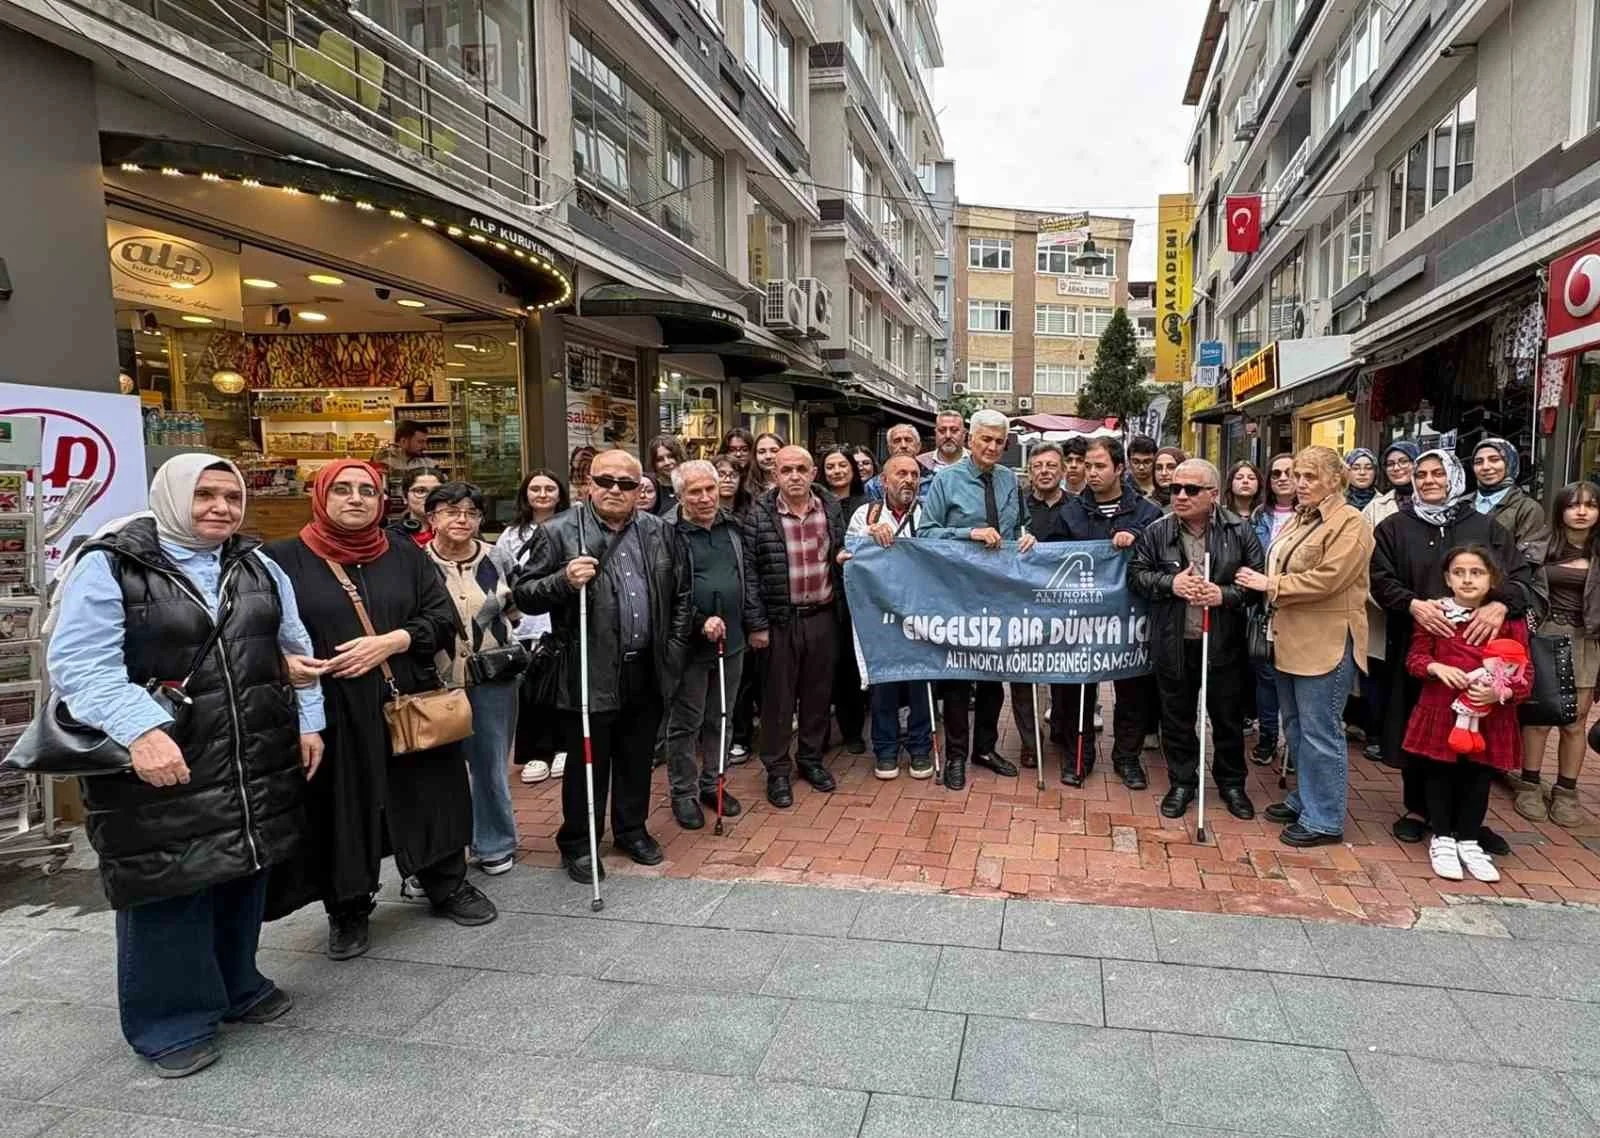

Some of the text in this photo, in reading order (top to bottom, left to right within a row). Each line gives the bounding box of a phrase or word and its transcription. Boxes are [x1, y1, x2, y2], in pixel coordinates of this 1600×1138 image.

[470, 217, 496, 233] ALP
[121, 242, 201, 275] alp
[1165, 228, 1177, 312] AKADEMİ
[903, 607, 1001, 647] ENGELSİZ
[1008, 607, 1043, 647] BİR
[1050, 609, 1121, 645] DÜNYA
[946, 647, 1149, 673] ALTI NOKTA KÖRLER DERNEĞİ SAMSUN
